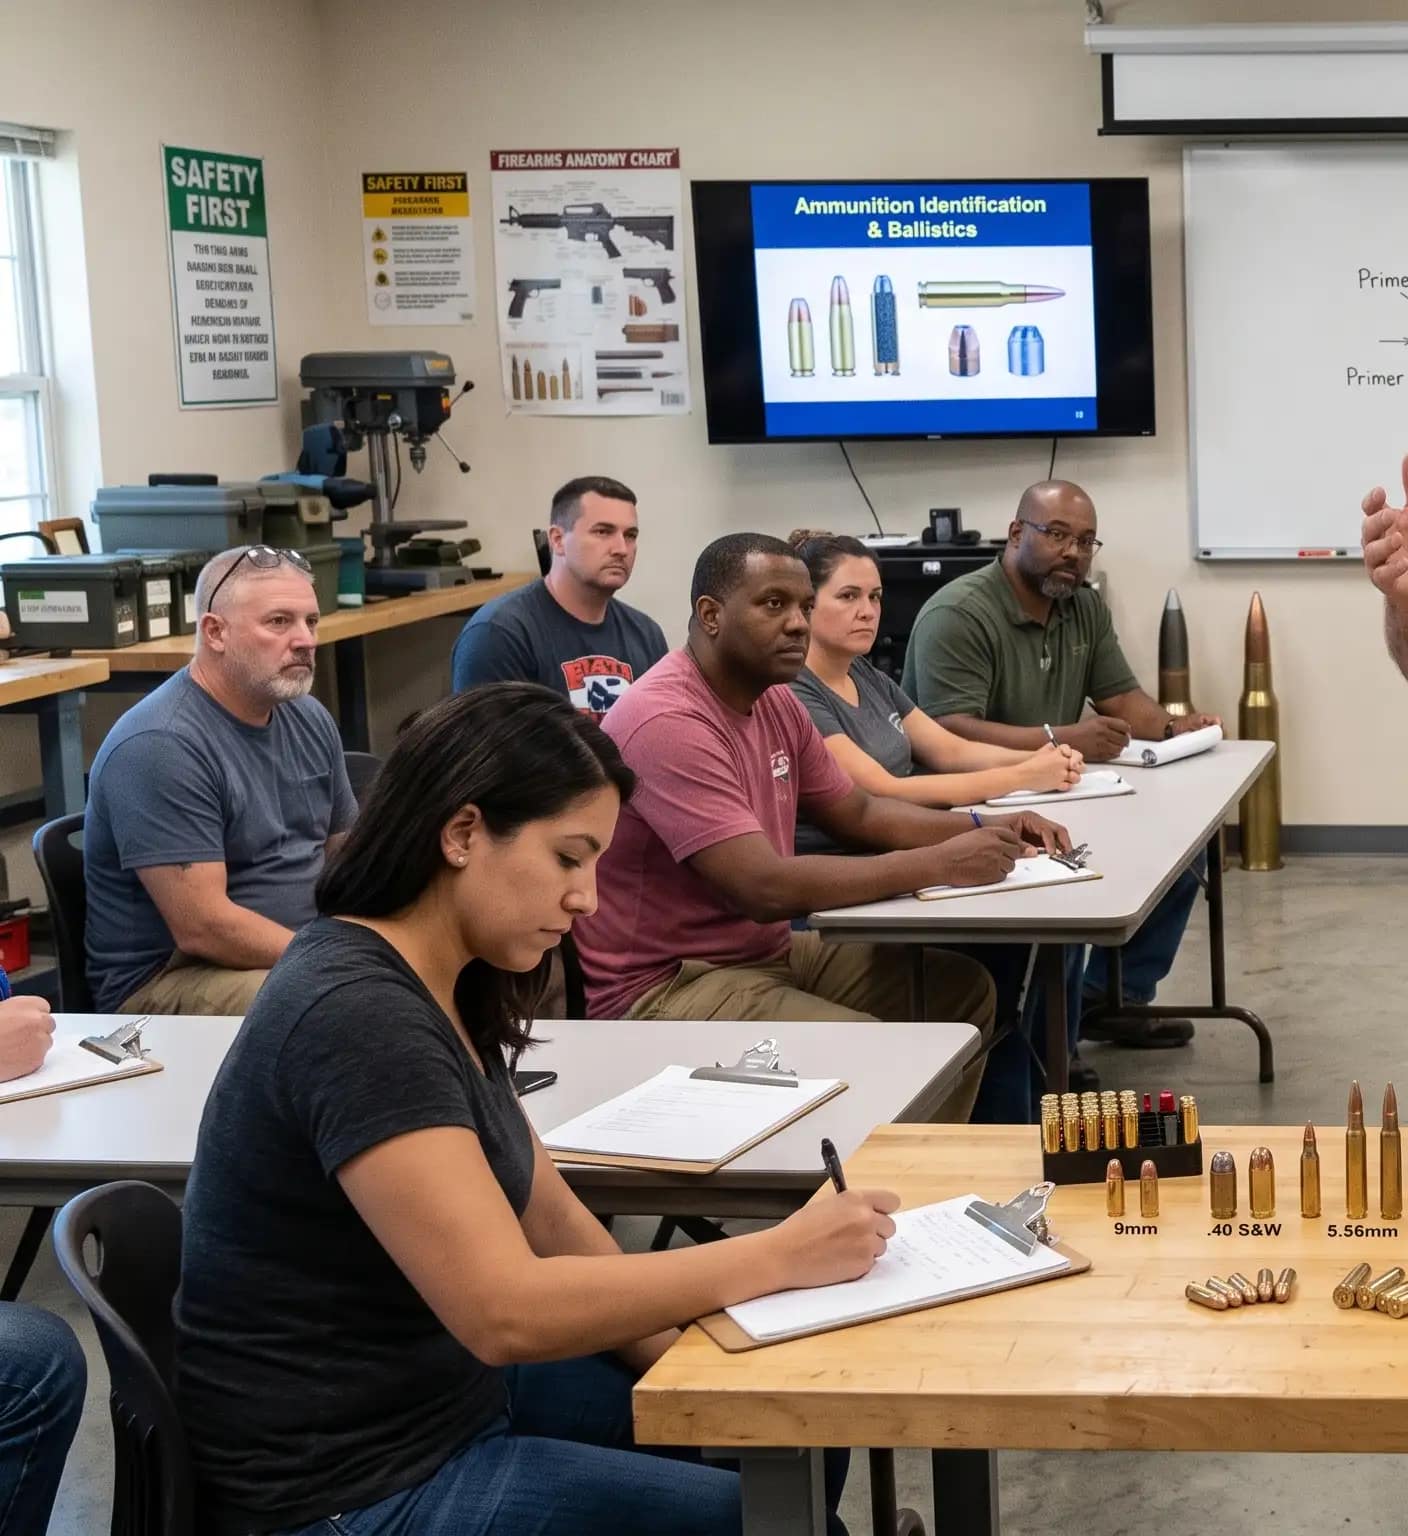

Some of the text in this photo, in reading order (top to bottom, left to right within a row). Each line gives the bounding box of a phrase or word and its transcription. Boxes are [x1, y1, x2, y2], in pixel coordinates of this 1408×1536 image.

[498, 151, 673, 168] FIREARMS ANATOMY CHART
[171, 156, 258, 195] SAFETY
[367, 175, 465, 190] SAFETY FIRST
[186, 193, 250, 228] FIRST
[794, 194, 1047, 216] Ammunition Identification
[867, 219, 978, 239] & Ballistics
[1346, 366, 1404, 386] Primer
[1114, 1223, 1158, 1237] 9mm
[1207, 1223, 1282, 1237] .40 S&W
[1327, 1225, 1399, 1239] 5.56mm
